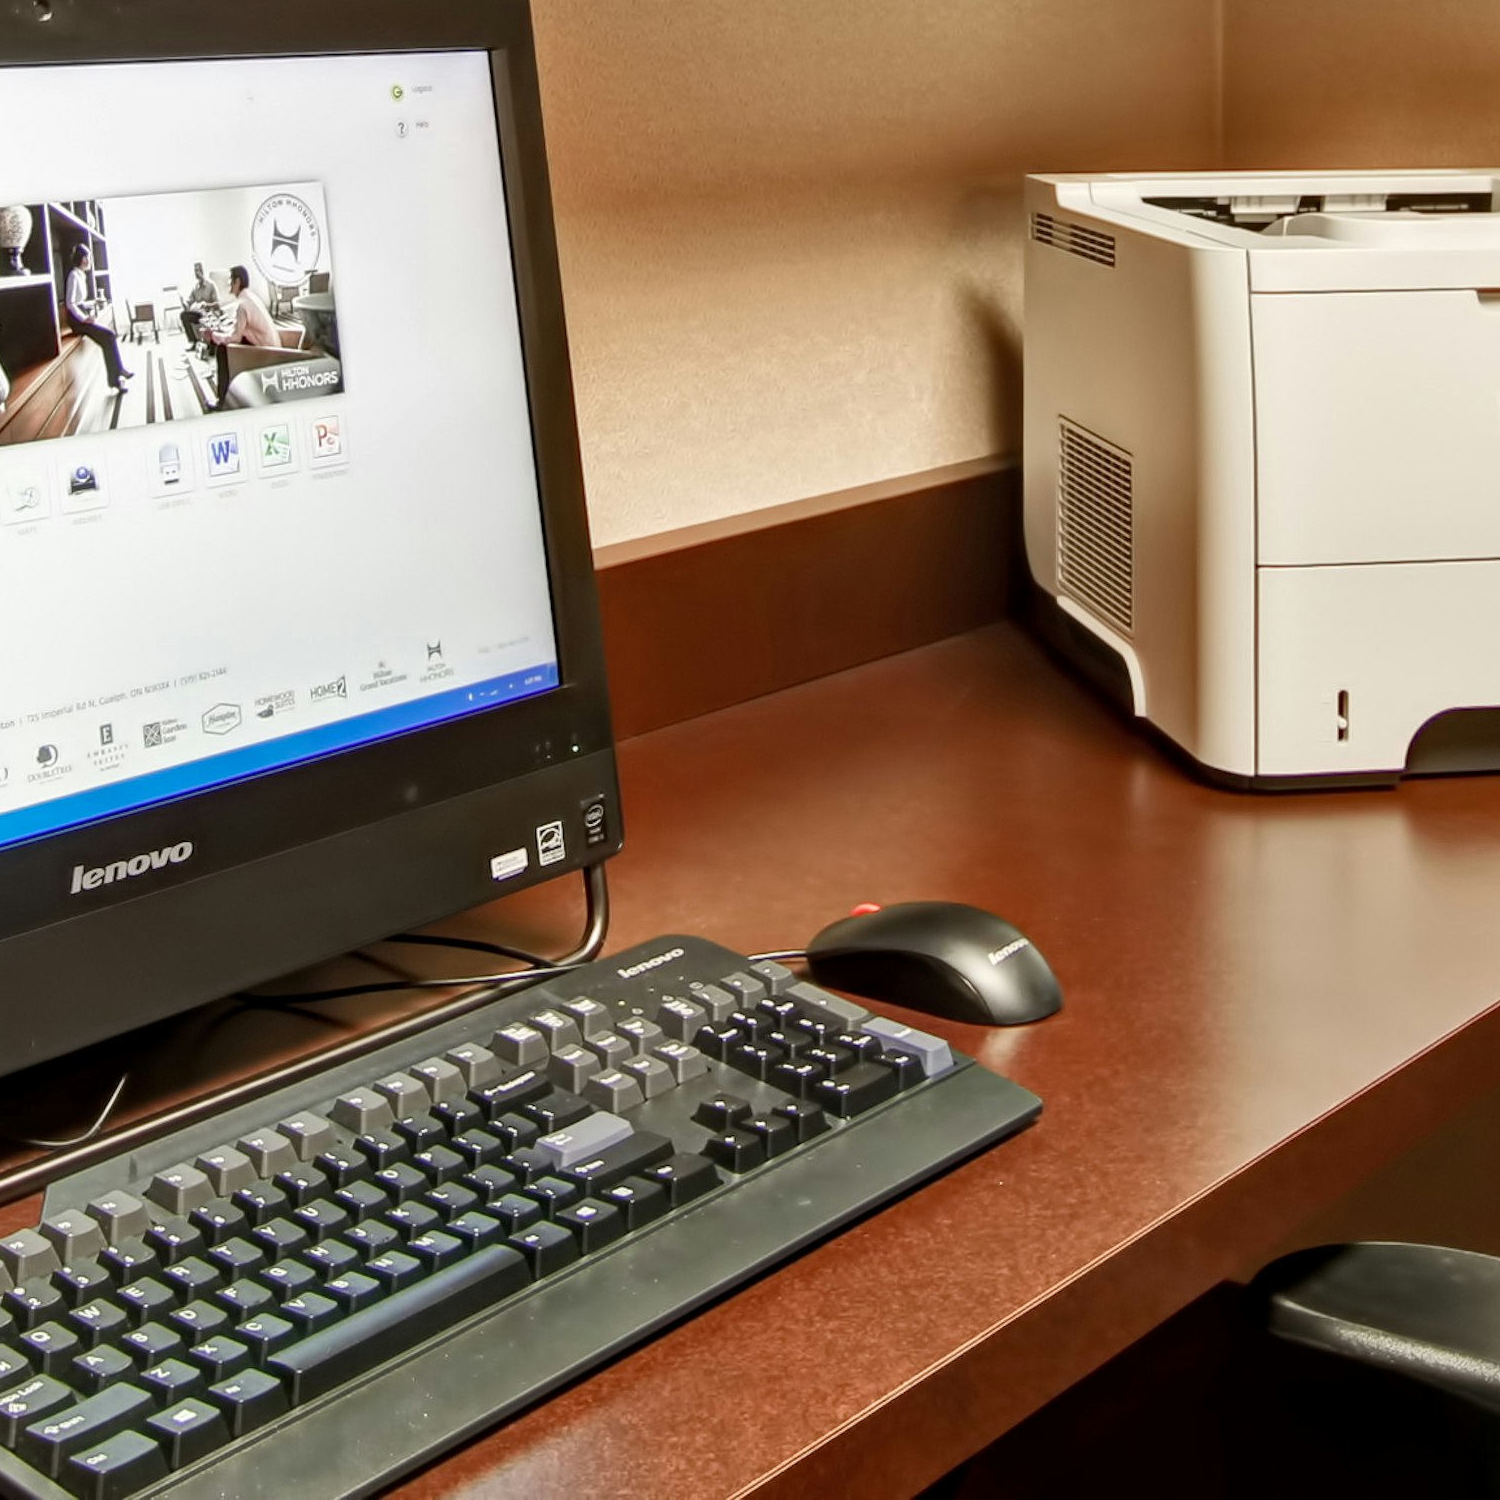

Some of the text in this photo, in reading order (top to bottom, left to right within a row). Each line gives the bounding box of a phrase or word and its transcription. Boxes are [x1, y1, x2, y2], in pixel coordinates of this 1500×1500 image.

[281, 366, 309, 377] HILTON
[282, 371, 339, 391] HHONORS
[70, 840, 193, 895] lenovo
[617, 948, 684, 978] lenovo
[79, 1306, 100, 1319] W
